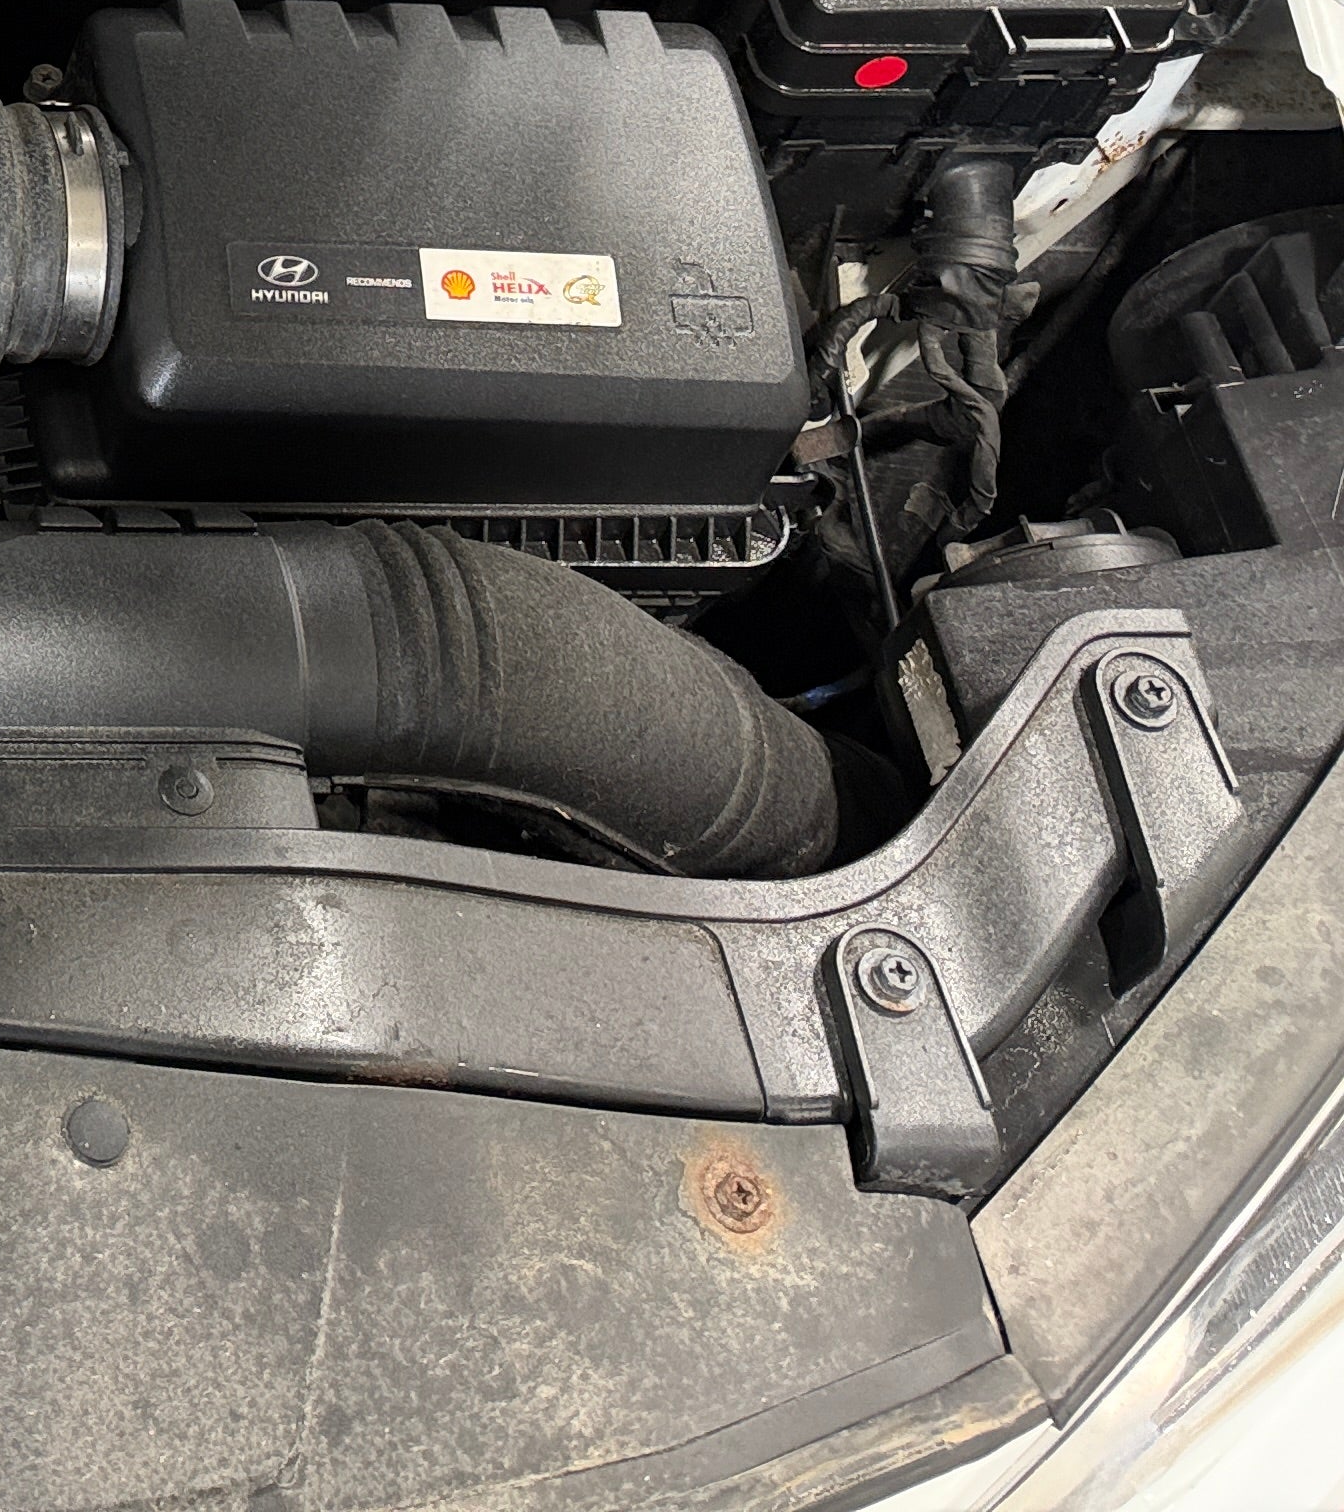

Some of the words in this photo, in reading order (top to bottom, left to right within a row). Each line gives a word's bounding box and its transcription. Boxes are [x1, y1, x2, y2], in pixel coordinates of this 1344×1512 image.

[490, 271, 516, 282] Shell
[251, 289, 329, 304] HYUNDAI
[346, 276, 413, 288] RECOMMENDS
[492, 279, 553, 296] HELIX
